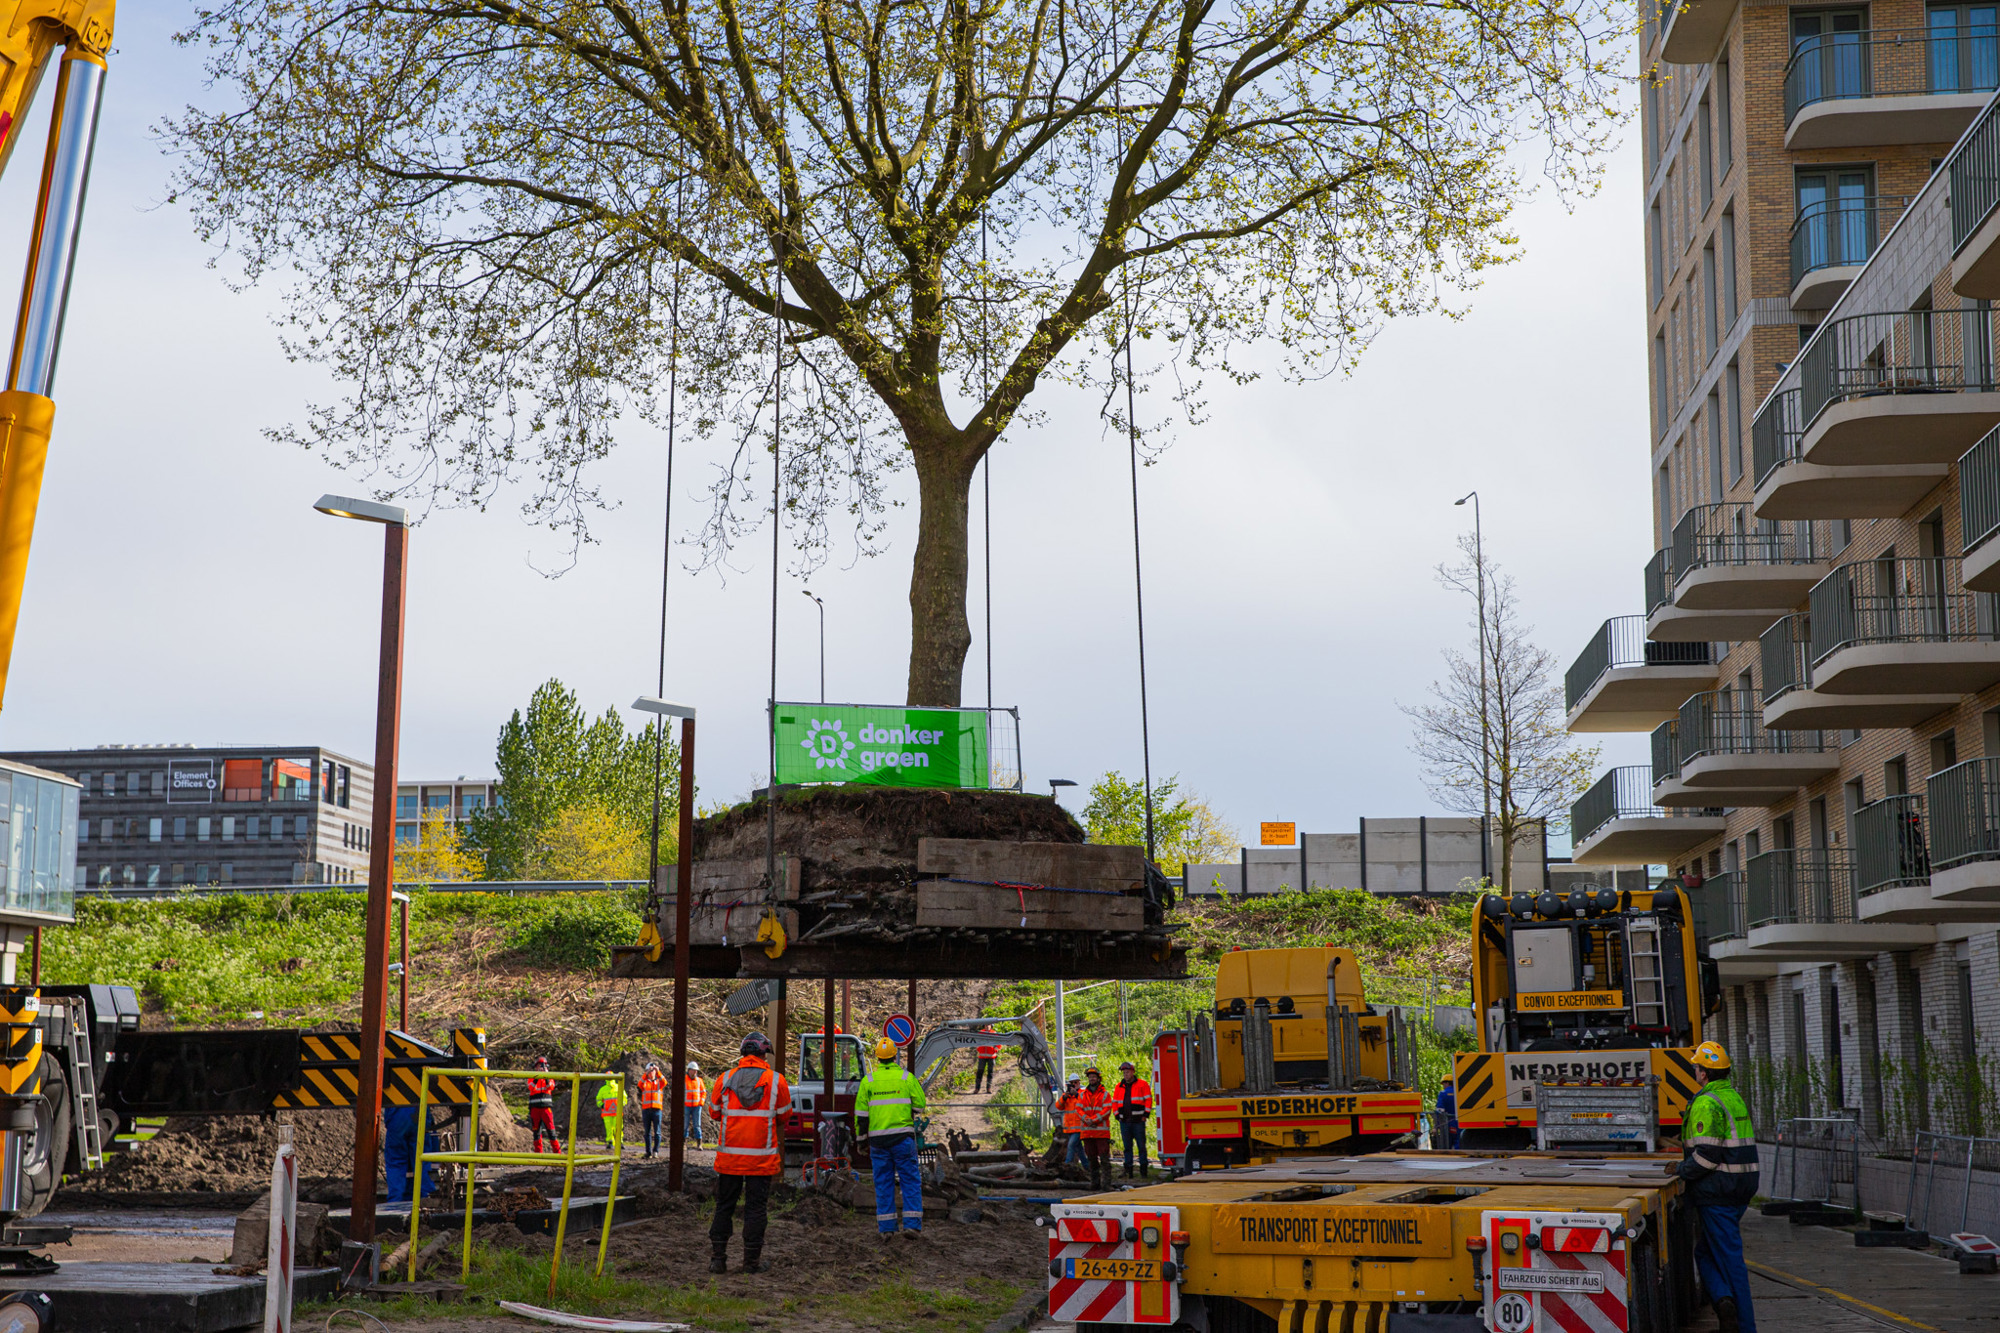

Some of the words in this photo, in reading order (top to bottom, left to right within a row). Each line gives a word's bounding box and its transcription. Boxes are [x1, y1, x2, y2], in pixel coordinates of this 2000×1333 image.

[858, 723, 943, 745] donker
[860, 750, 929, 772] groen
[173, 780, 203, 788] Offices
[174, 771, 208, 779] Element
[1523, 995, 1556, 1008] CONVOI
[1558, 993, 1616, 1007] EXCEPTIONNEL
[1510, 1061, 1646, 1081] NEDERHOFF
[1241, 1097, 1357, 1115] NEDERHOFF
[1239, 1217, 1319, 1243] TRANSPORT
[1323, 1218, 1423, 1245] EXCEPTIONNEL
[1081, 1261, 1153, 1278] 26-49-ZZ
[1503, 1273, 1546, 1284] FAHRZEUG
[1548, 1276, 1580, 1286] SCHERT
[1582, 1277, 1599, 1286] AUS
[1502, 1303, 1523, 1324] 80
